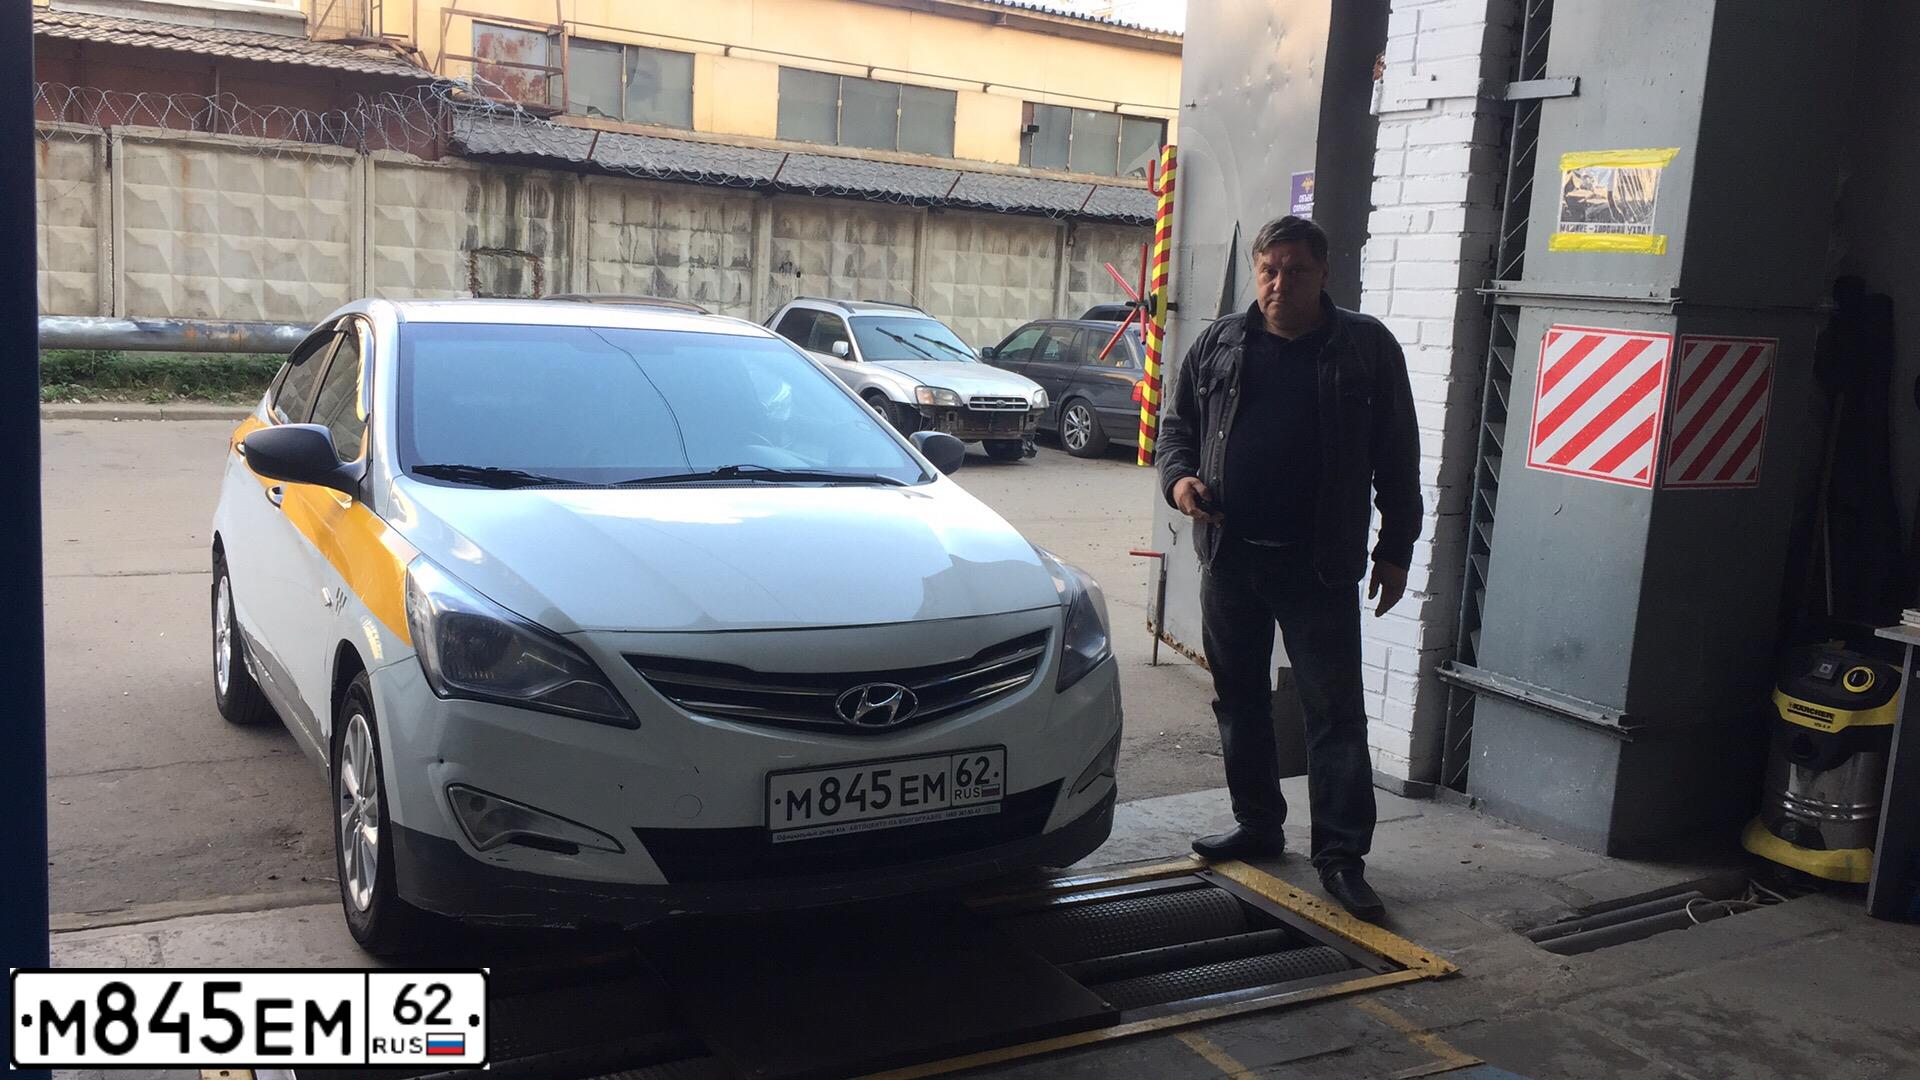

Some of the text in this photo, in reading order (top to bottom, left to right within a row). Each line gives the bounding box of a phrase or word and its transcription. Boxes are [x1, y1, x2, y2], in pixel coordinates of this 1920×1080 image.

[786, 756, 990, 821] М845ЕМ 62
[955, 786, 980, 800] RUS
